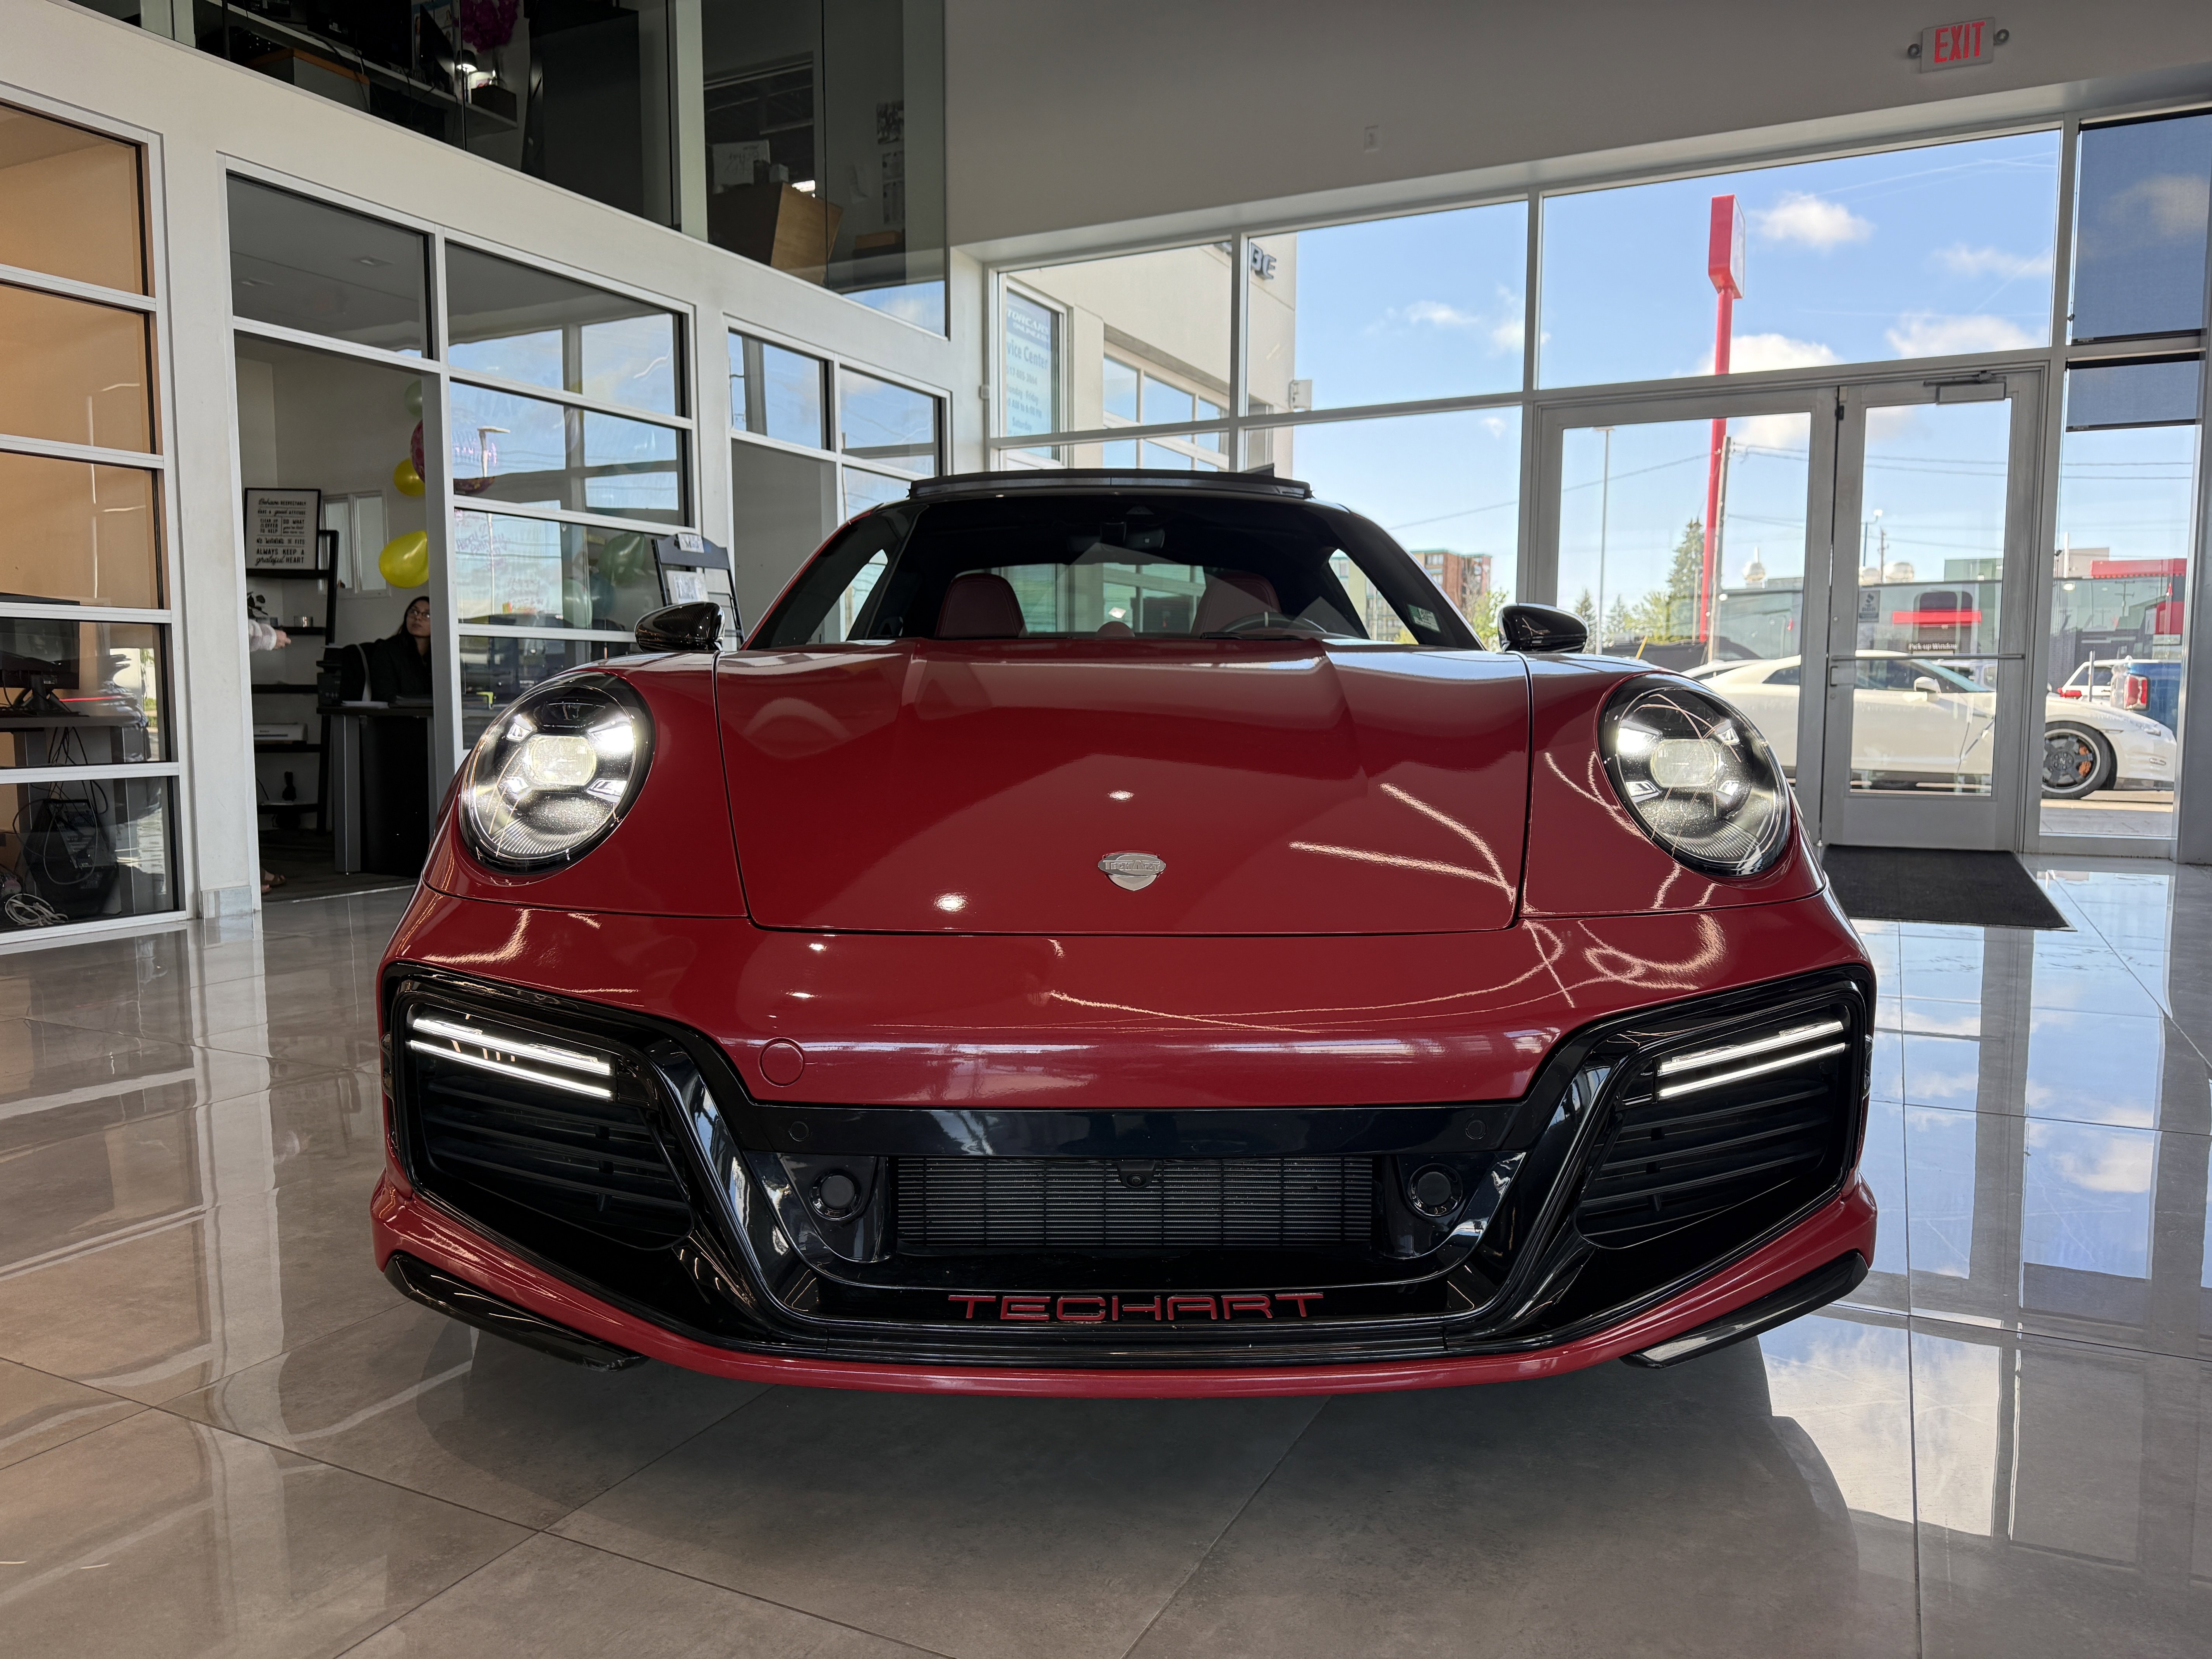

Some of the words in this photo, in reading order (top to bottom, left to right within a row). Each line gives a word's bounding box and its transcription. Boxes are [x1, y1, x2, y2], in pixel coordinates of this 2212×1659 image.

[1934, 21, 1986, 64] EXIT
[1024, 346, 1048, 370] Center
[283, 548, 297, 556] KEEP
[255, 554, 285, 566] grateful
[1908, 643, 1932, 651] Pick-up
[1103, 860, 1161, 871] TECHART
[948, 1293, 1324, 1322] TECHART
